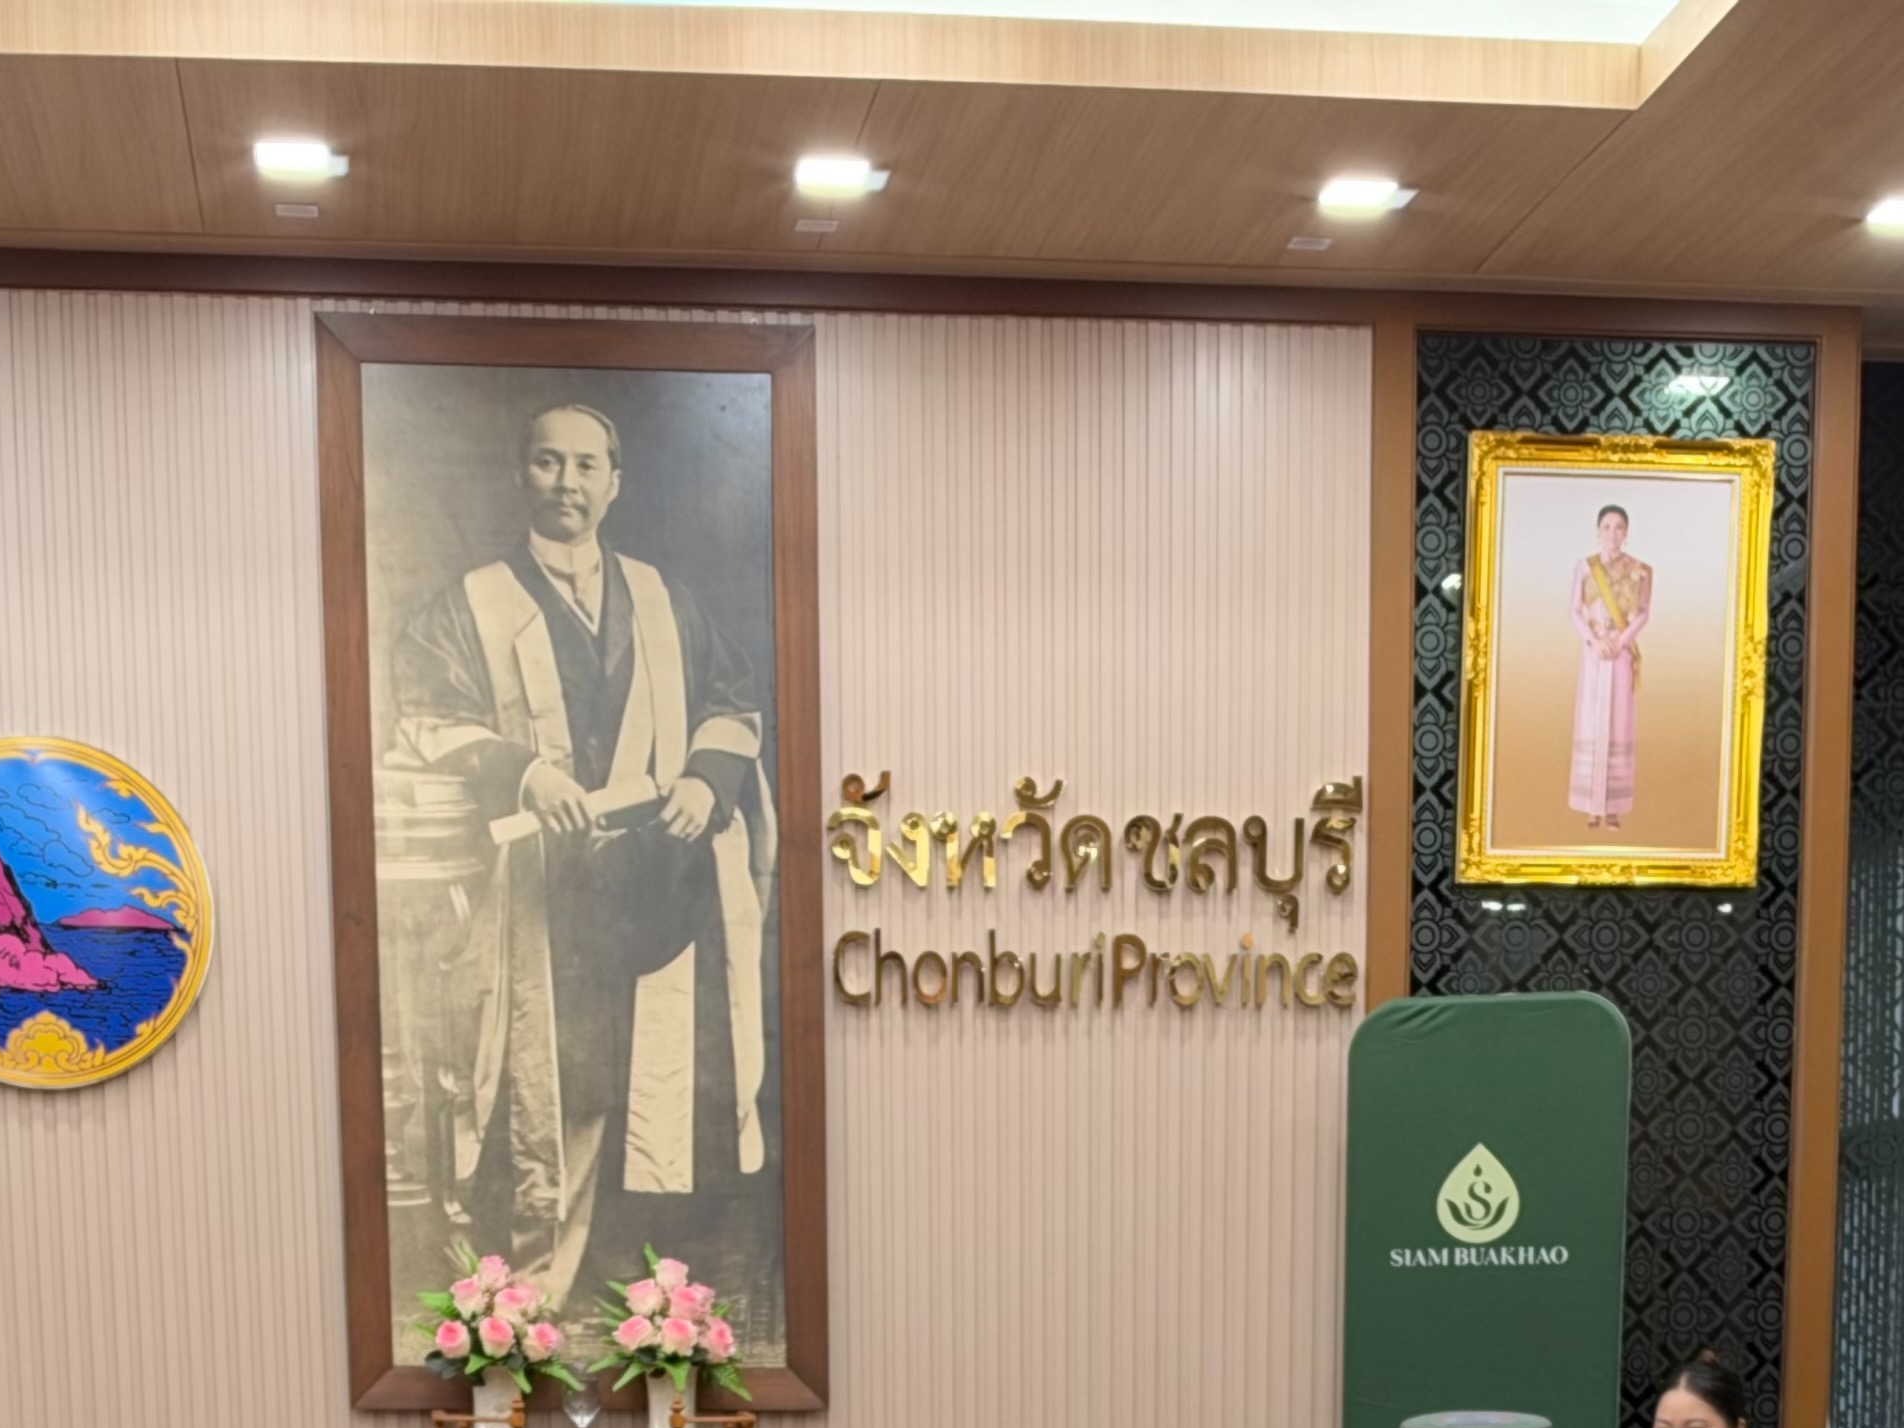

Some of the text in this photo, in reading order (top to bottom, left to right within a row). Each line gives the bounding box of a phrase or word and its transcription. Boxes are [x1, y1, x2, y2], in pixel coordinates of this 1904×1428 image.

[827, 771, 1364, 932] จังหวัดชลบุรี
[1389, 1245, 1570, 1268] SIAM BUAKHAO
